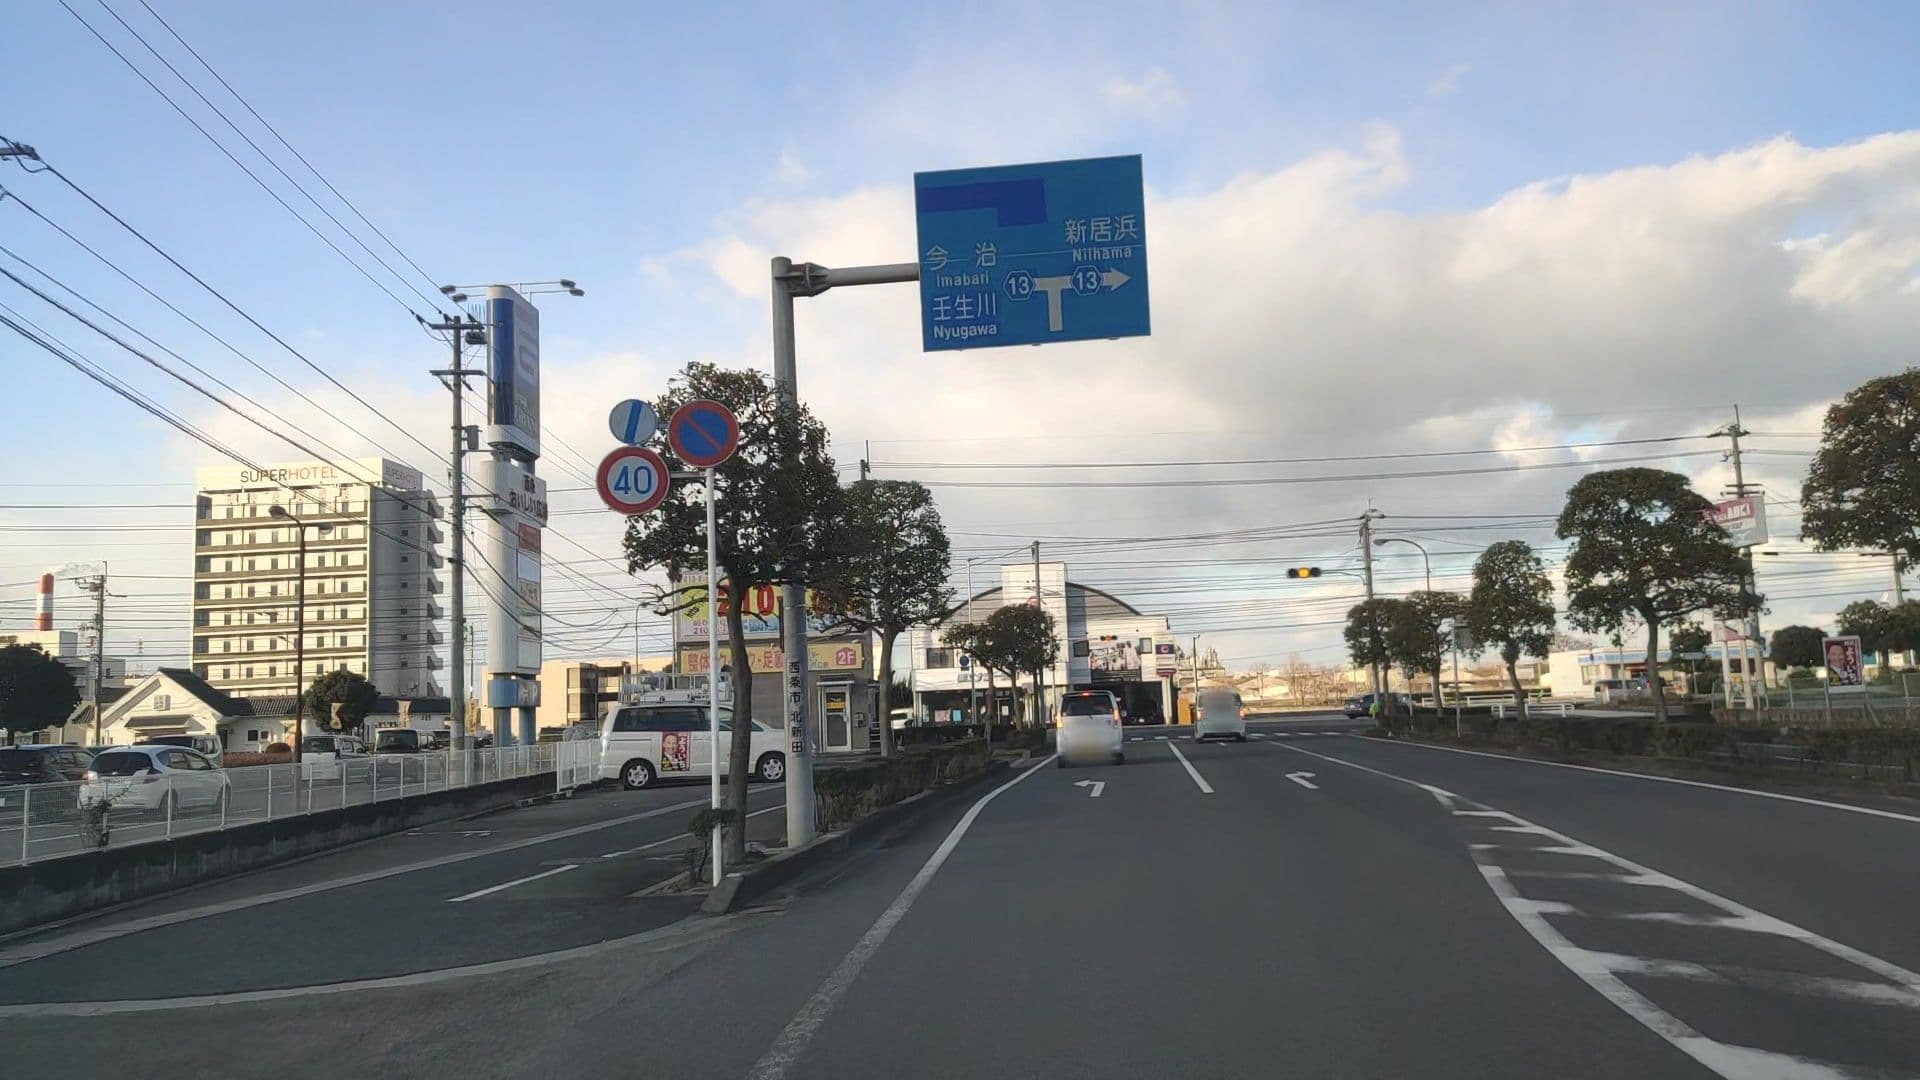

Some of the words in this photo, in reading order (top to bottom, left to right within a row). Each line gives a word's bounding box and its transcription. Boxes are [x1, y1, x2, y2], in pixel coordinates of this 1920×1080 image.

[1065, 215, 1138, 244] 新居浜
[1072, 246, 1132, 262] Niihama
[936, 270, 989, 288] Imabari
[1007, 277, 1030, 295] 13
[1075, 271, 1097, 290] 13
[932, 293, 997, 321] 壬生川
[933, 322, 997, 341] Nyugawa
[613, 465, 652, 494] 40
[837, 651, 856, 665] 2F
[789, 661, 802, 753] 西条市北新田
